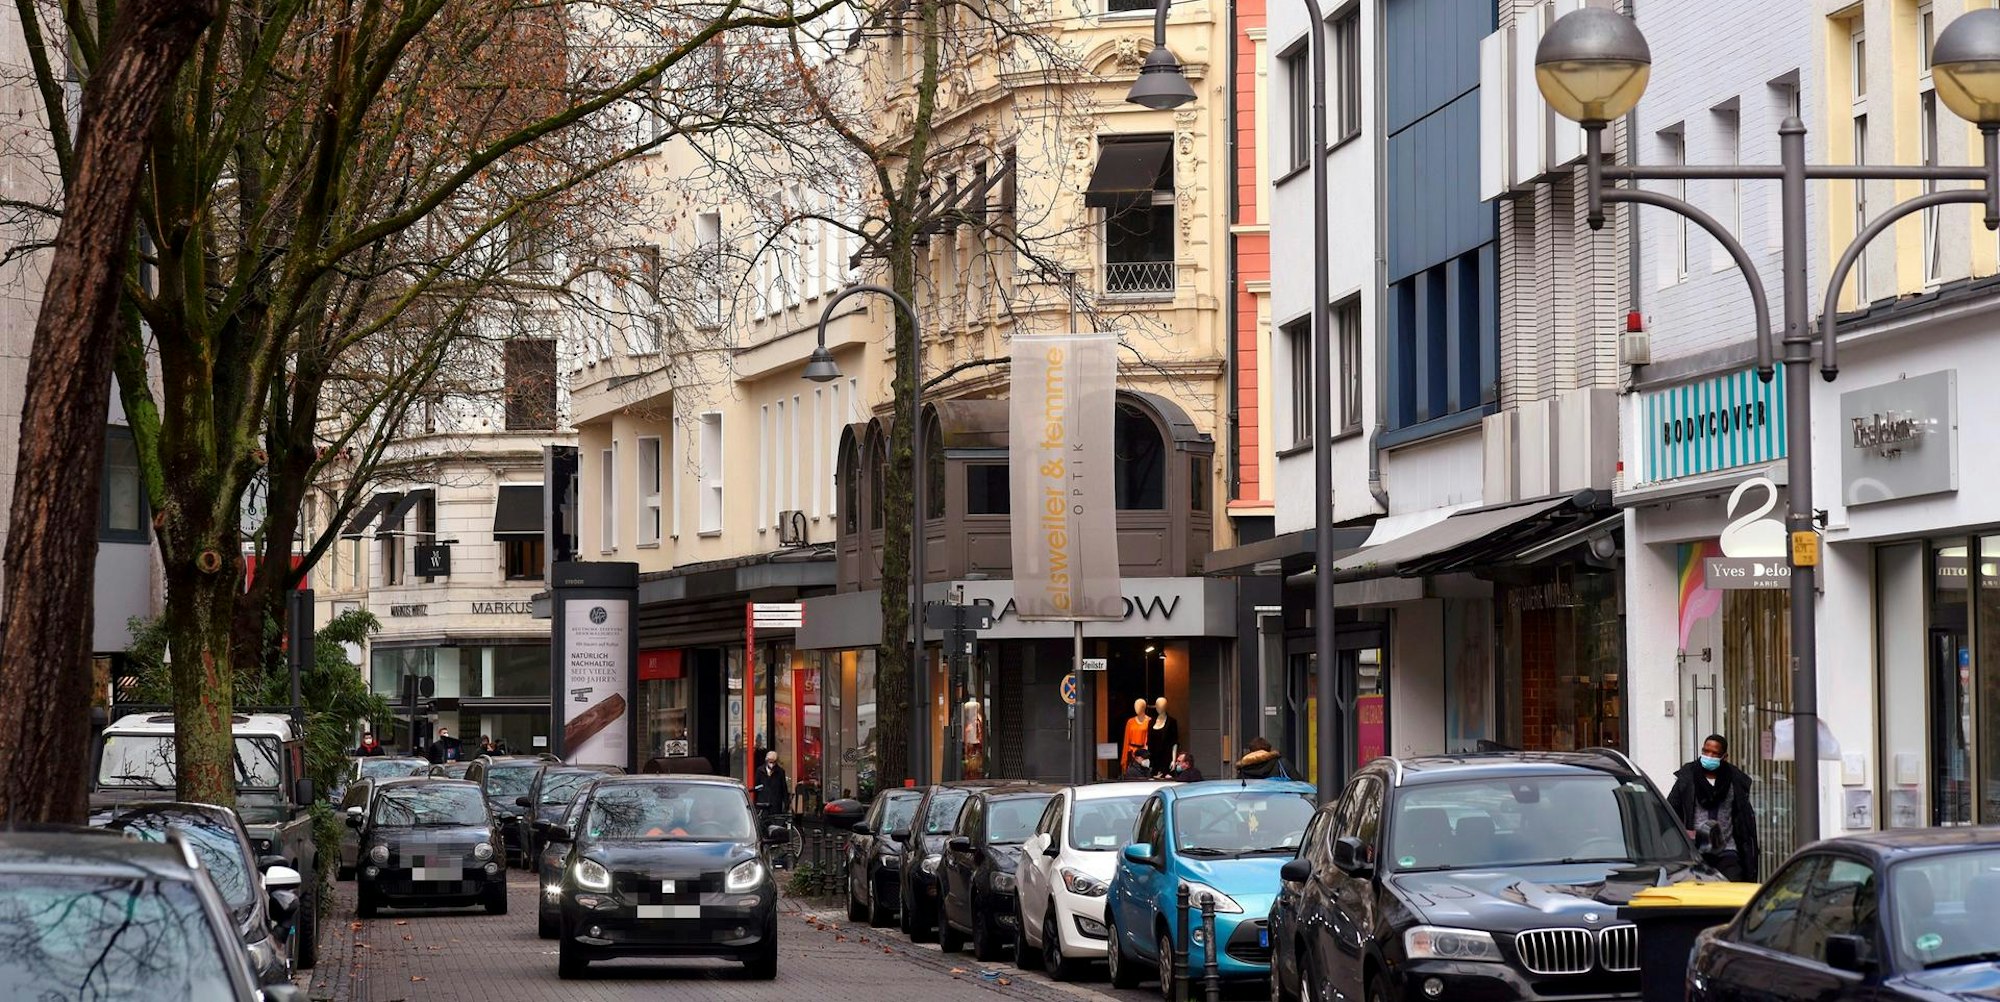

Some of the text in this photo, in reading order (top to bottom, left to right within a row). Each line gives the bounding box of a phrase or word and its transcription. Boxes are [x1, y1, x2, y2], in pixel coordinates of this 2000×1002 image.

[1664, 400, 1766, 447] BODYCOVER
[1040, 346, 1071, 613] elsweiler & temme
[1073, 443, 1084, 516] OPTIK
[1711, 563, 1746, 577] Yves
[1753, 580, 1779, 588] PARIS
[472, 602, 533, 614] MARKUS
